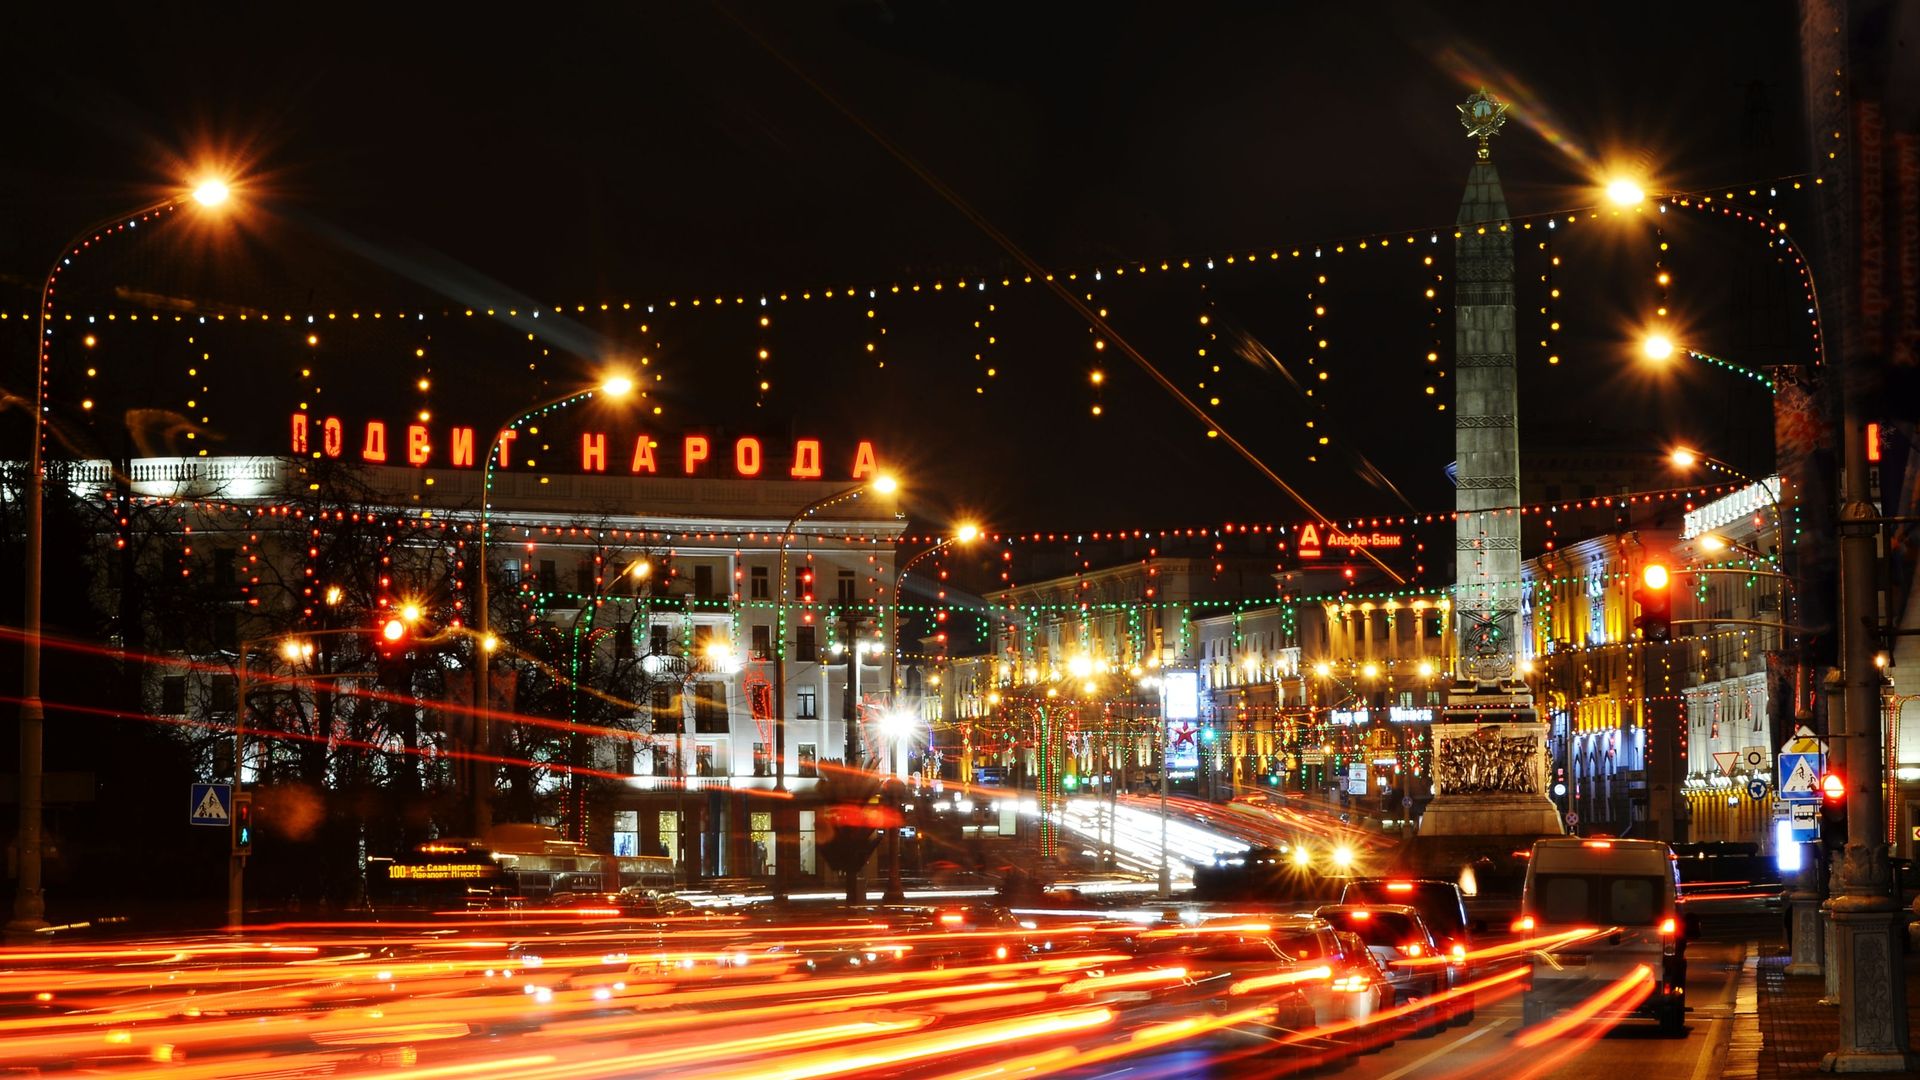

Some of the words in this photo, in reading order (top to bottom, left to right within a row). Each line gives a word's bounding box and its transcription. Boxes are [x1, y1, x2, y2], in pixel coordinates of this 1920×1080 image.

[293, 414, 516, 467] ПОДВИГ
[582, 433, 879, 478] НАРОДА
[389, 865, 406, 878] 100
